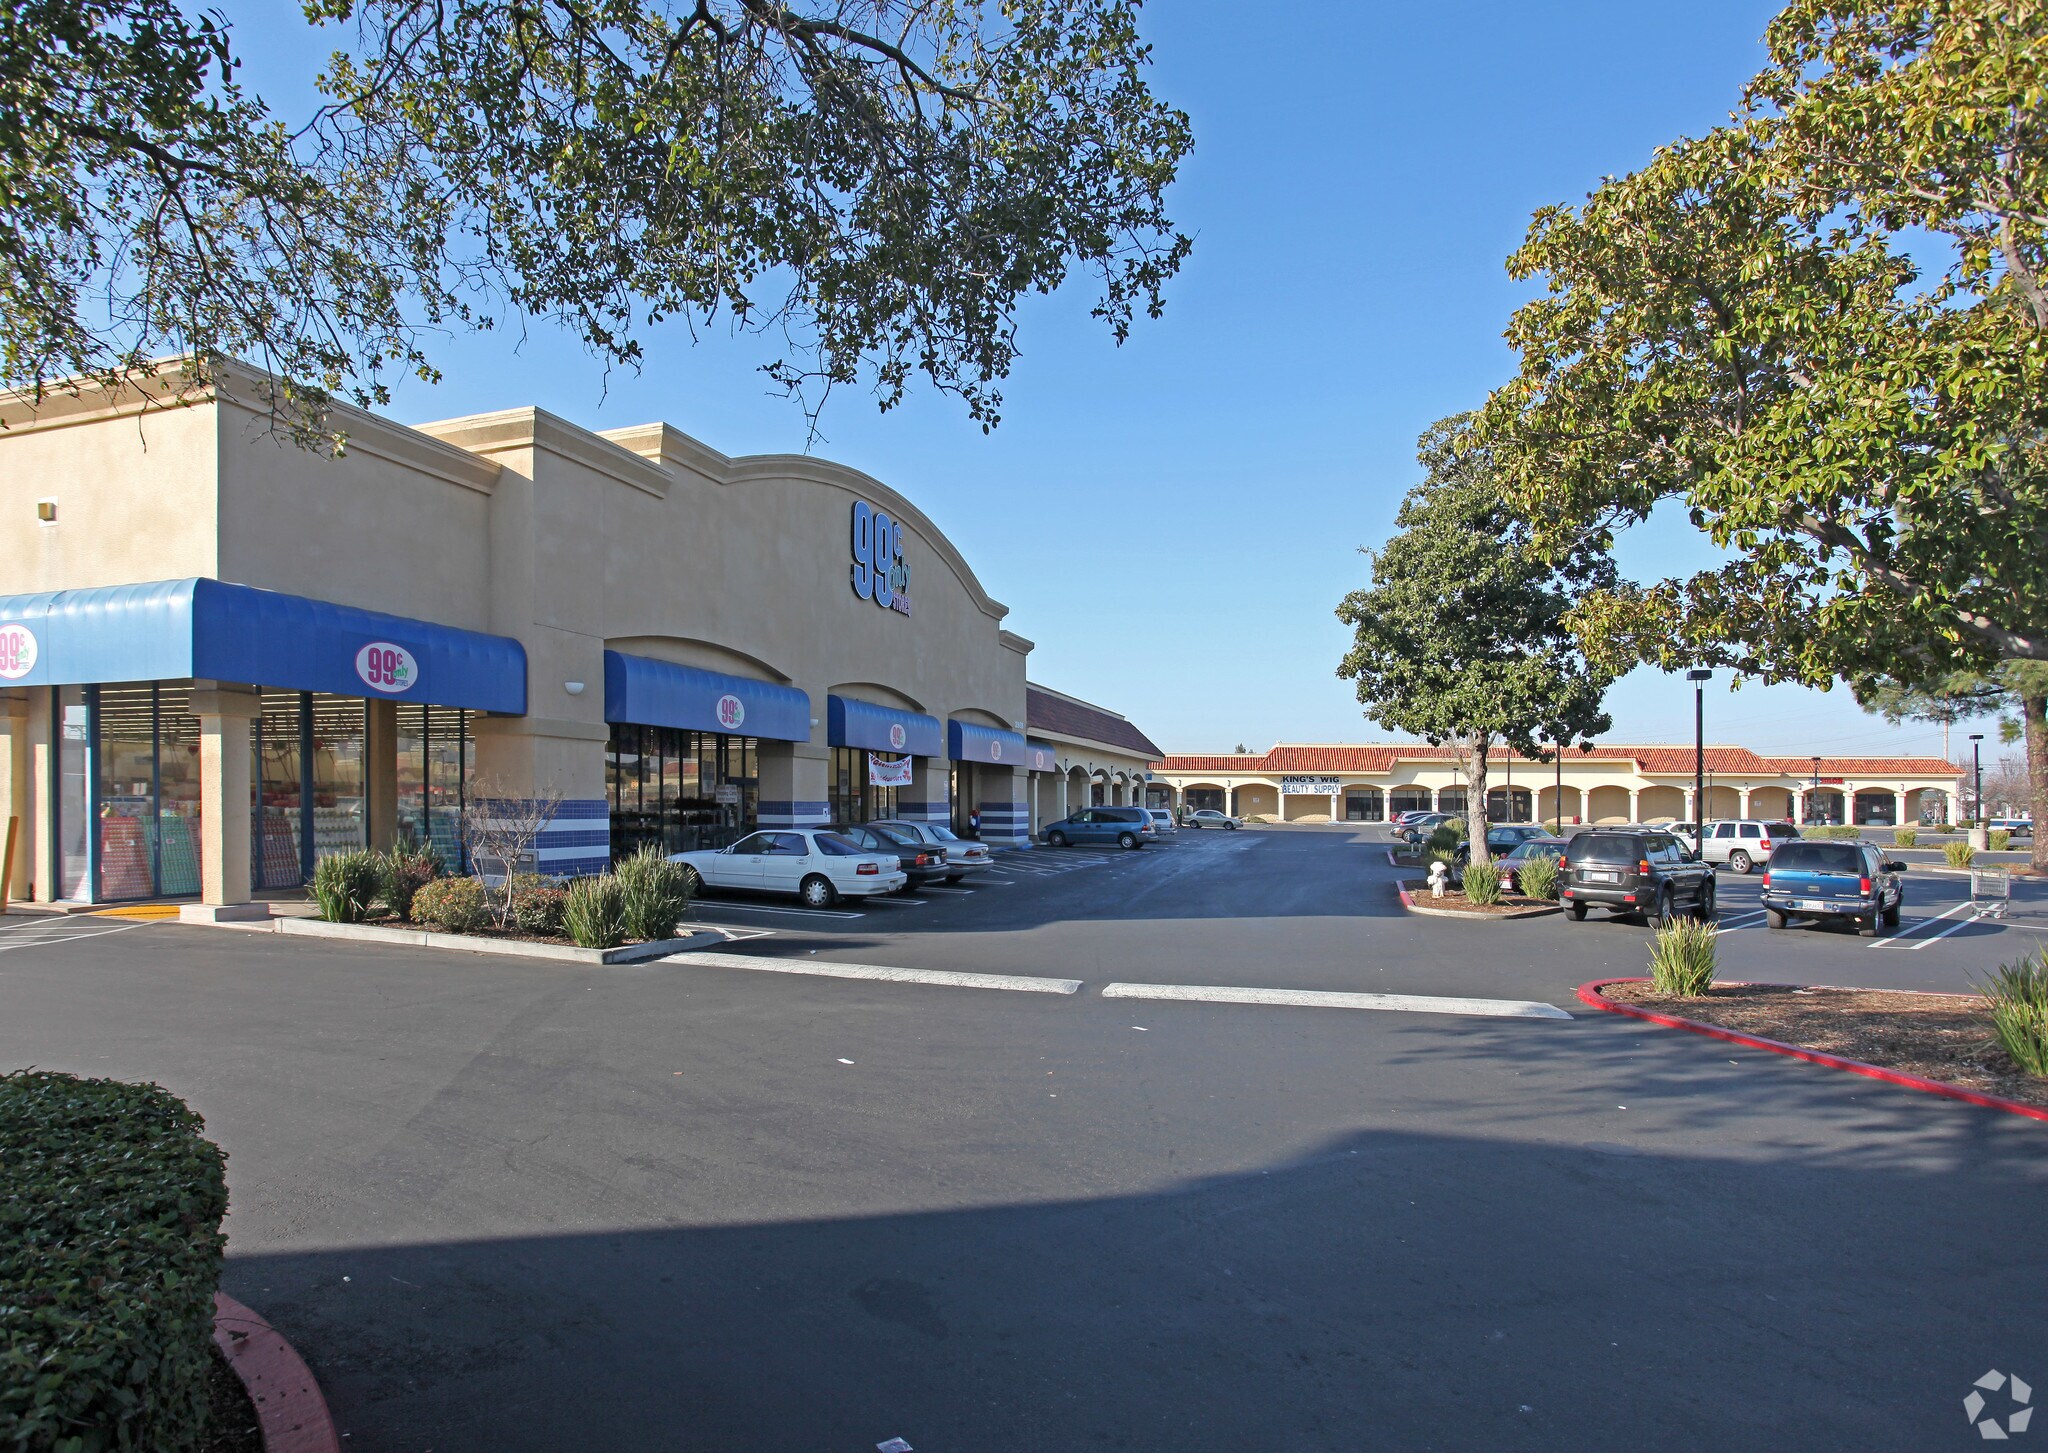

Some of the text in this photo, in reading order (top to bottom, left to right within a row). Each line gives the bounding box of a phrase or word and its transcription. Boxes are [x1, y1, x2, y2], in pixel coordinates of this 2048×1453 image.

[888, 556, 911, 594] only
[1282, 775, 1340, 783] KING'S WIG
[1282, 784, 1340, 794] BEAUTY SUPPLY
